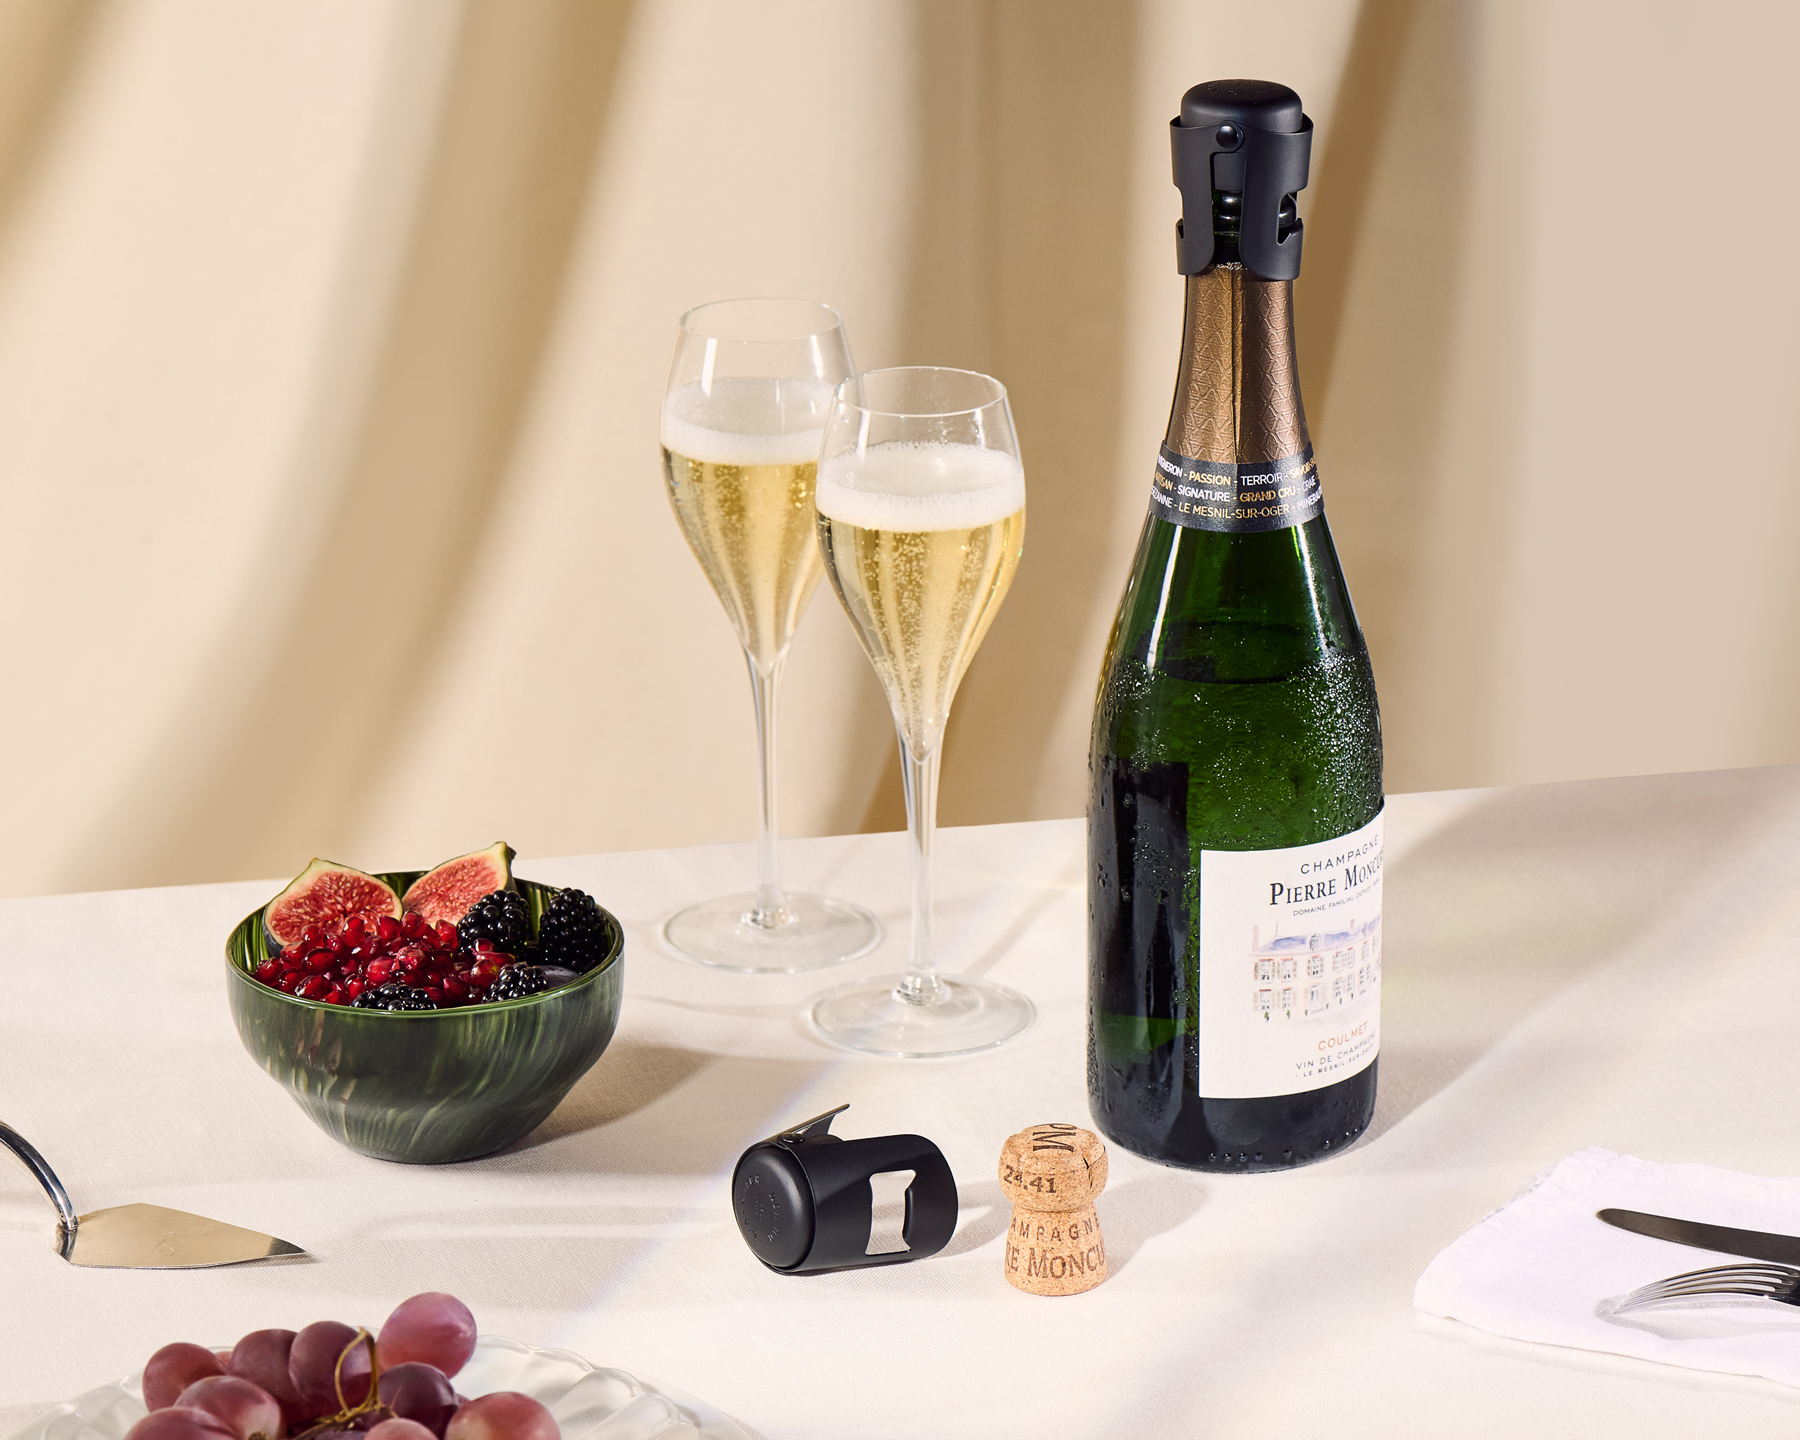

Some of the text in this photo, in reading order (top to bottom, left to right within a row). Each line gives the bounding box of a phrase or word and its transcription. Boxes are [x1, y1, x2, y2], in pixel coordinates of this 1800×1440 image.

[1189, 471, 1231, 485] PASSION
[1240, 472, 1282, 486] TERROIR
[1177, 484, 1230, 502] SIGNATURE
[1240, 490, 1276, 502] GRAND
[1278, 486, 1296, 499] CRU
[1178, 502, 1191, 513] LE
[1192, 504, 1290, 519] MESNIL-SUR-OGER
[1300, 834, 1378, 875] CHAMPAGNE
[1293, 904, 1326, 917] DOMAINE
[1328, 896, 1354, 909] FAMILIAL
[1318, 1020, 1368, 1051] COULMET
[1296, 1060, 1314, 1070] VIN
[1320, 1055, 1332, 1065] DE
[1303, 1070, 1313, 1078] LE
